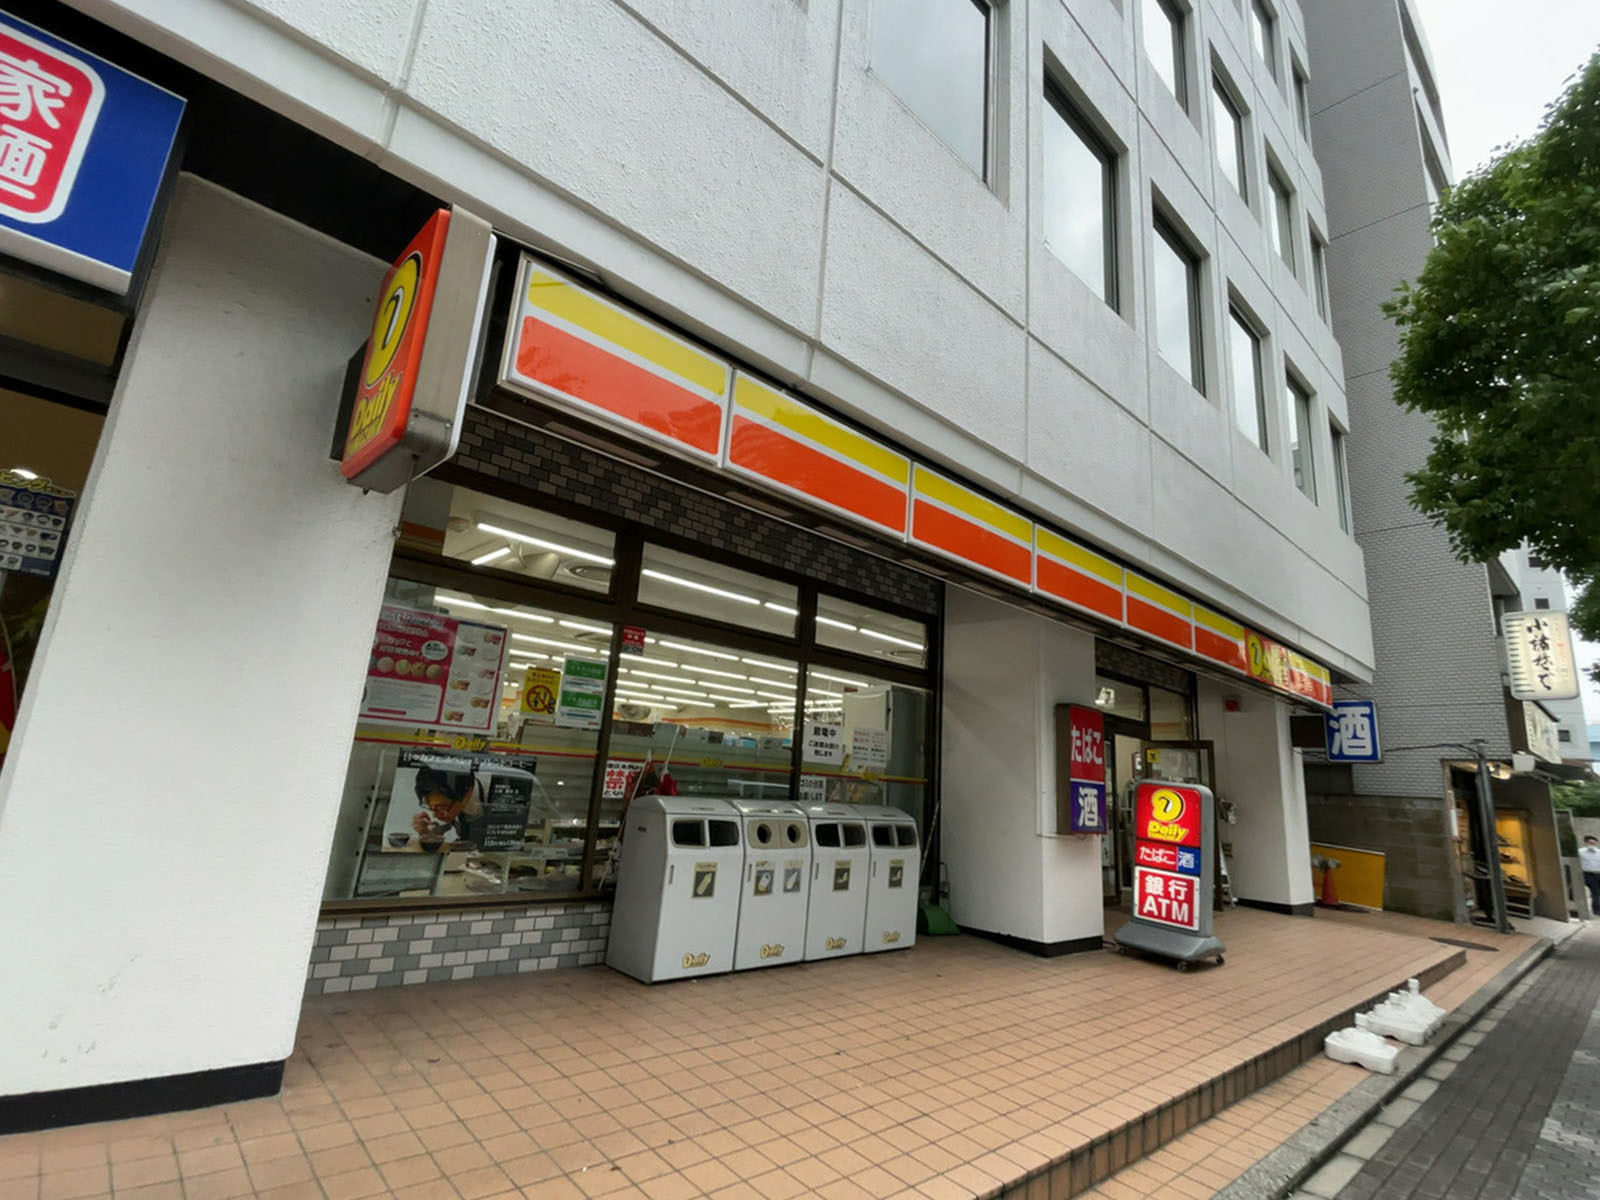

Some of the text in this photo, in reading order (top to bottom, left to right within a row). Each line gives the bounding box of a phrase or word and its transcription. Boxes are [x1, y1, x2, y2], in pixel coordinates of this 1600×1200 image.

[1070, 725, 1103, 765] たばこ
[1328, 706, 1373, 756] 酒
[1078, 786, 1099, 827] 酒
[1147, 820, 1189, 842] Daily
[1139, 845, 1176, 865] たばこ
[1178, 851, 1195, 869] 酒
[1144, 874, 1188, 901] 銀行
[1143, 894, 1190, 923] ATM
